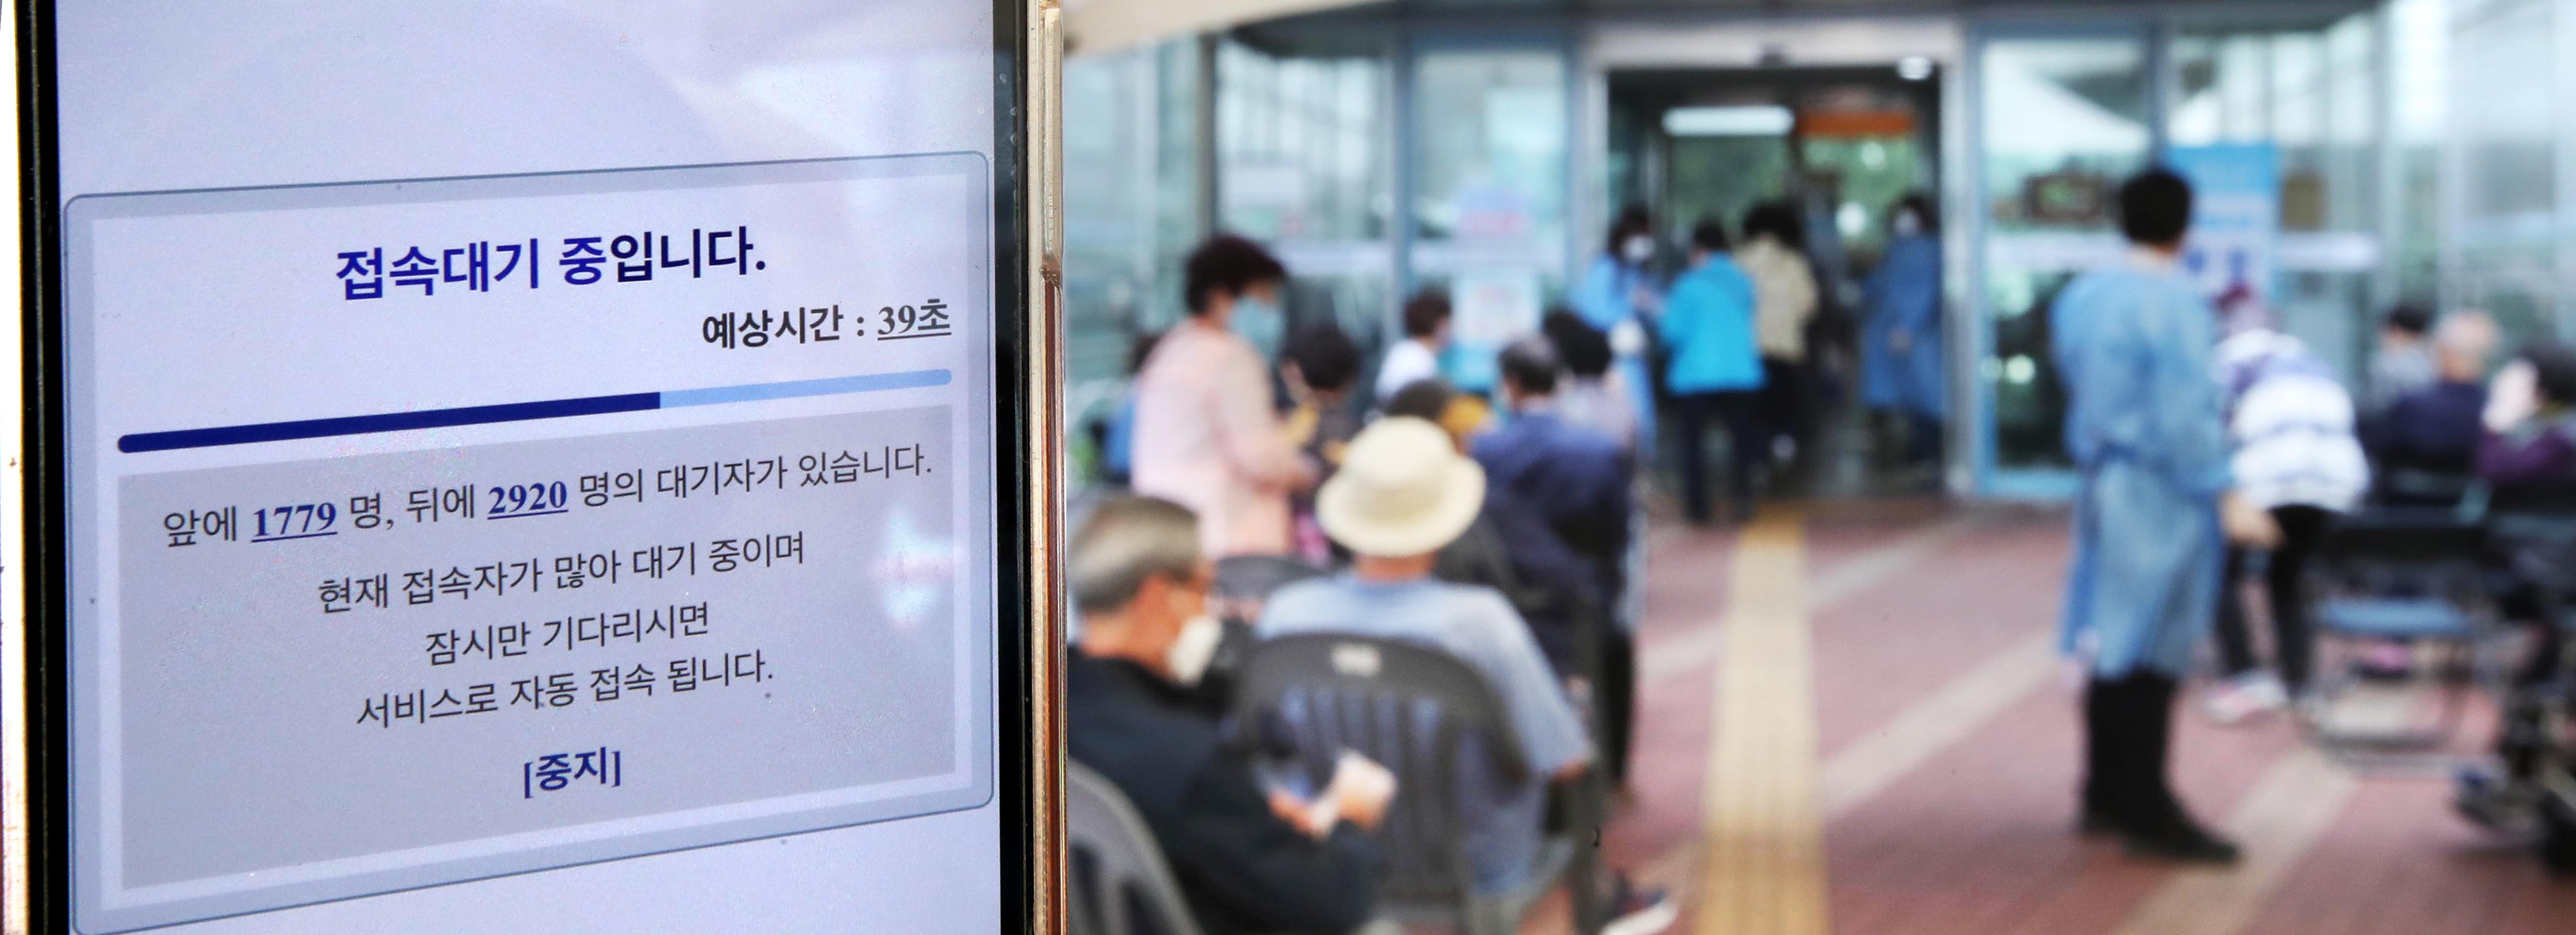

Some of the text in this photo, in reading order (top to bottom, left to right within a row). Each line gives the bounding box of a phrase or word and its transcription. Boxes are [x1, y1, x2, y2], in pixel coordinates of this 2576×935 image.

[335, 225, 766, 301] 접속대기 중입니다.
[702, 304, 844, 350] 예상시간
[877, 298, 952, 341] 39초
[163, 443, 932, 548] 앞에 1779 명, 뒤에 2920 명의 대기자가 있습니다.
[318, 530, 803, 614] 현재 접속자가 많아 대기 중이며
[426, 601, 708, 666] 잠시만 기다리시면
[356, 649, 773, 729] 서비스로 자동 접속 됩니다.
[523, 746, 621, 799] [중지]
